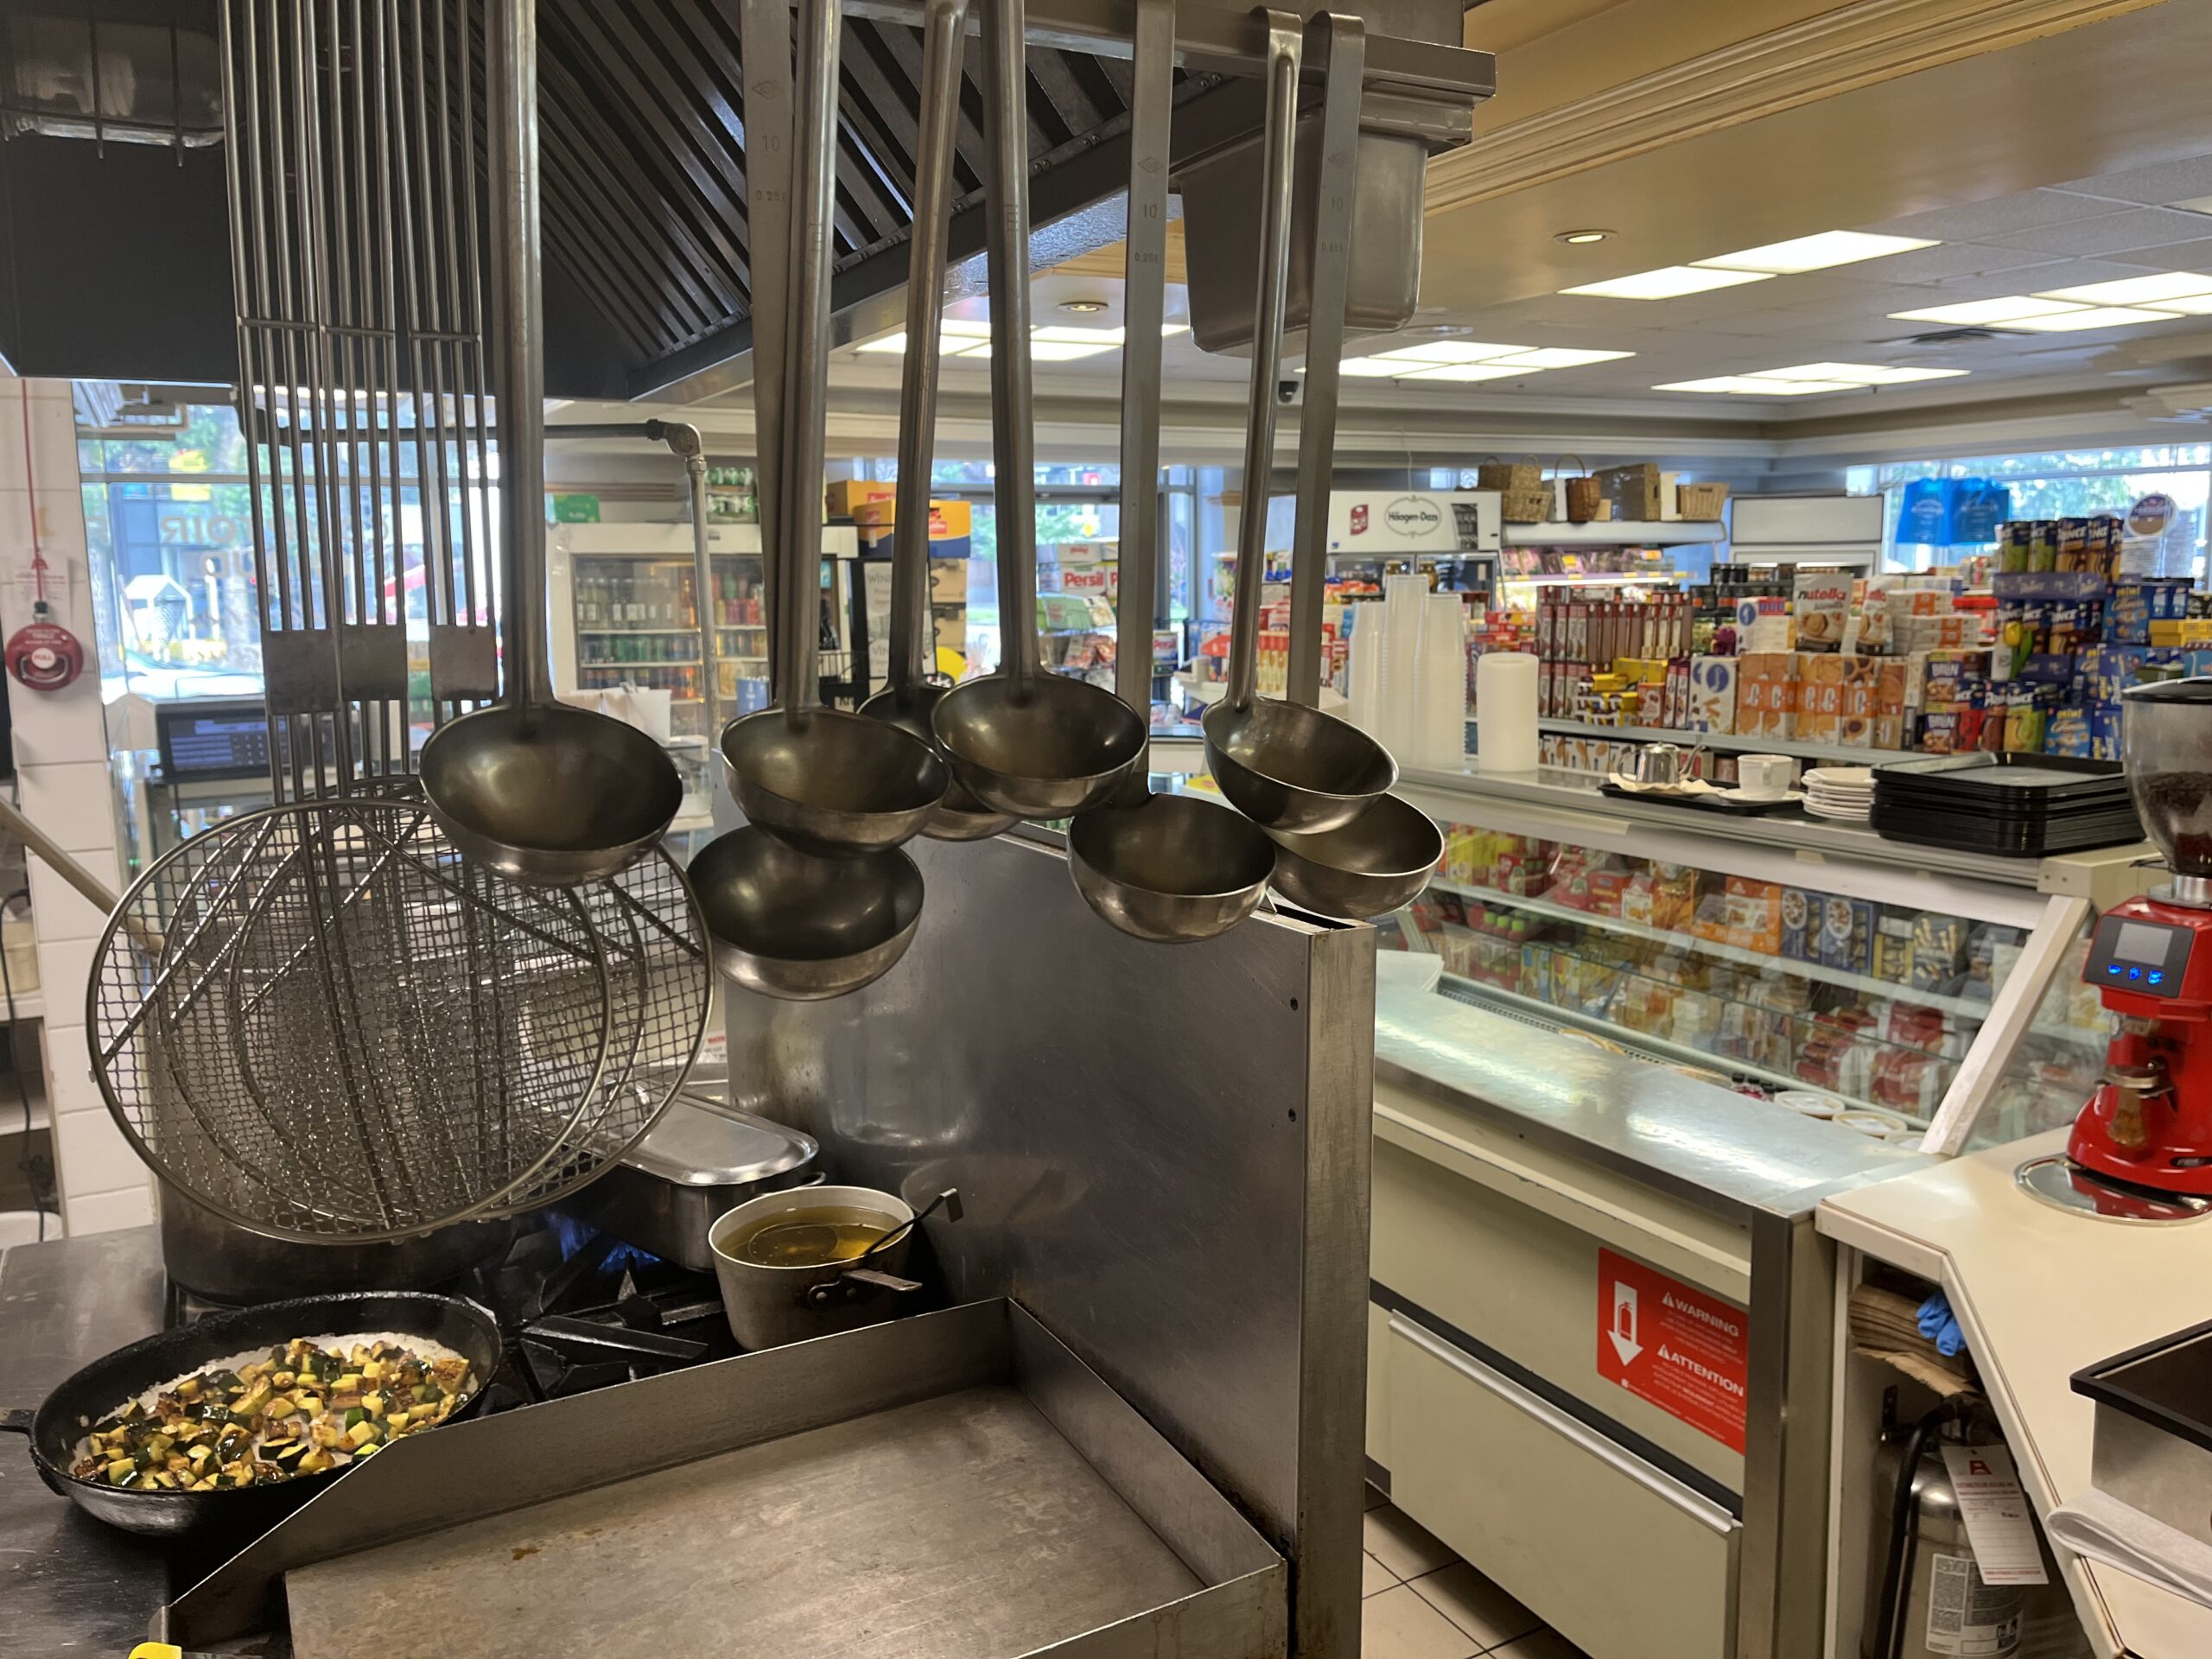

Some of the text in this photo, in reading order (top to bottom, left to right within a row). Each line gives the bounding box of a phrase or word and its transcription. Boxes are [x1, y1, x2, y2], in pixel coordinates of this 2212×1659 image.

[761, 134, 781, 153] 10
[1142, 203, 1158, 219] 10
[1064, 571, 1104, 588] Persil
[1797, 588, 1847, 601] nutella
[1675, 1298, 1740, 1338] WARNING
[1669, 1351, 1745, 1397] ATTENTION
